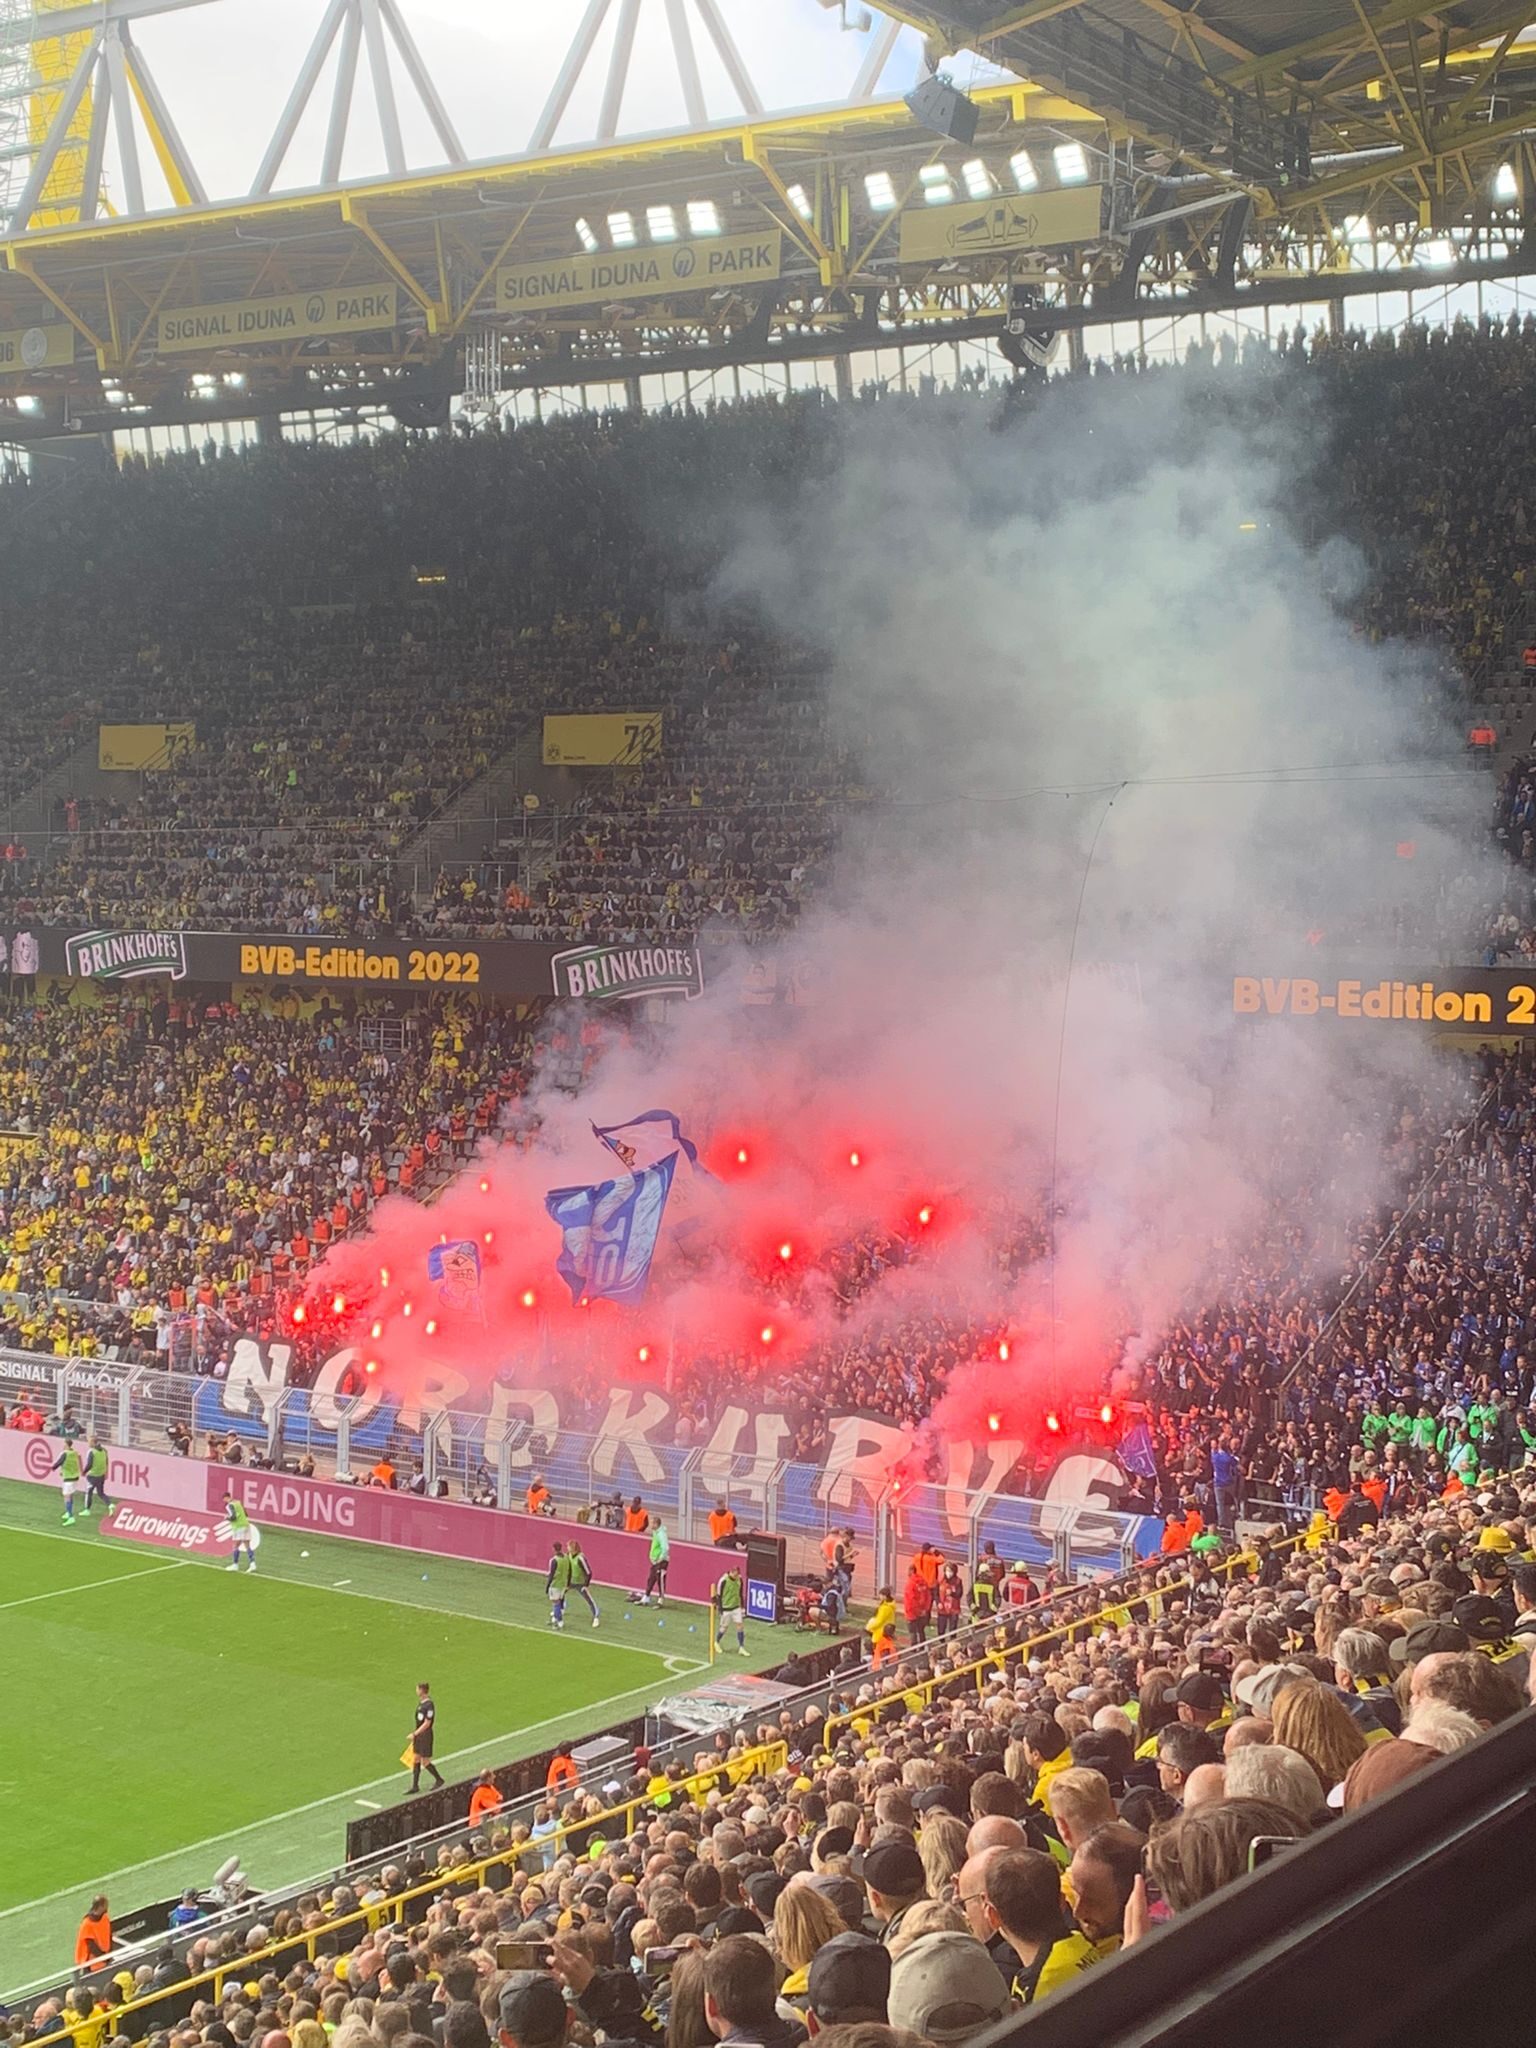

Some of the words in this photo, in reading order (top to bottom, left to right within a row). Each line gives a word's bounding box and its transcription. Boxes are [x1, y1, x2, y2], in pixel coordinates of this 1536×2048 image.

[504, 271, 583, 299] SIGNAL
[591, 260, 660, 290] IDUNA
[708, 244, 772, 274] PARK
[165, 317, 232, 340] SIGNAL
[238, 307, 296, 332] IDUNA
[336, 295, 389, 320] PARK
[624, 724, 656, 754] 72
[240, 945, 399, 980] BVB-Edition
[408, 950, 480, 983] 2022
[1232, 977, 1492, 1023] BVB-Edition
[0, 1361, 49, 1382] SIGNAL
[228, 1477, 355, 1527] LEADING
[113, 1507, 210, 1548] Eurowings
[750, 1588, 772, 1611] 1&1
